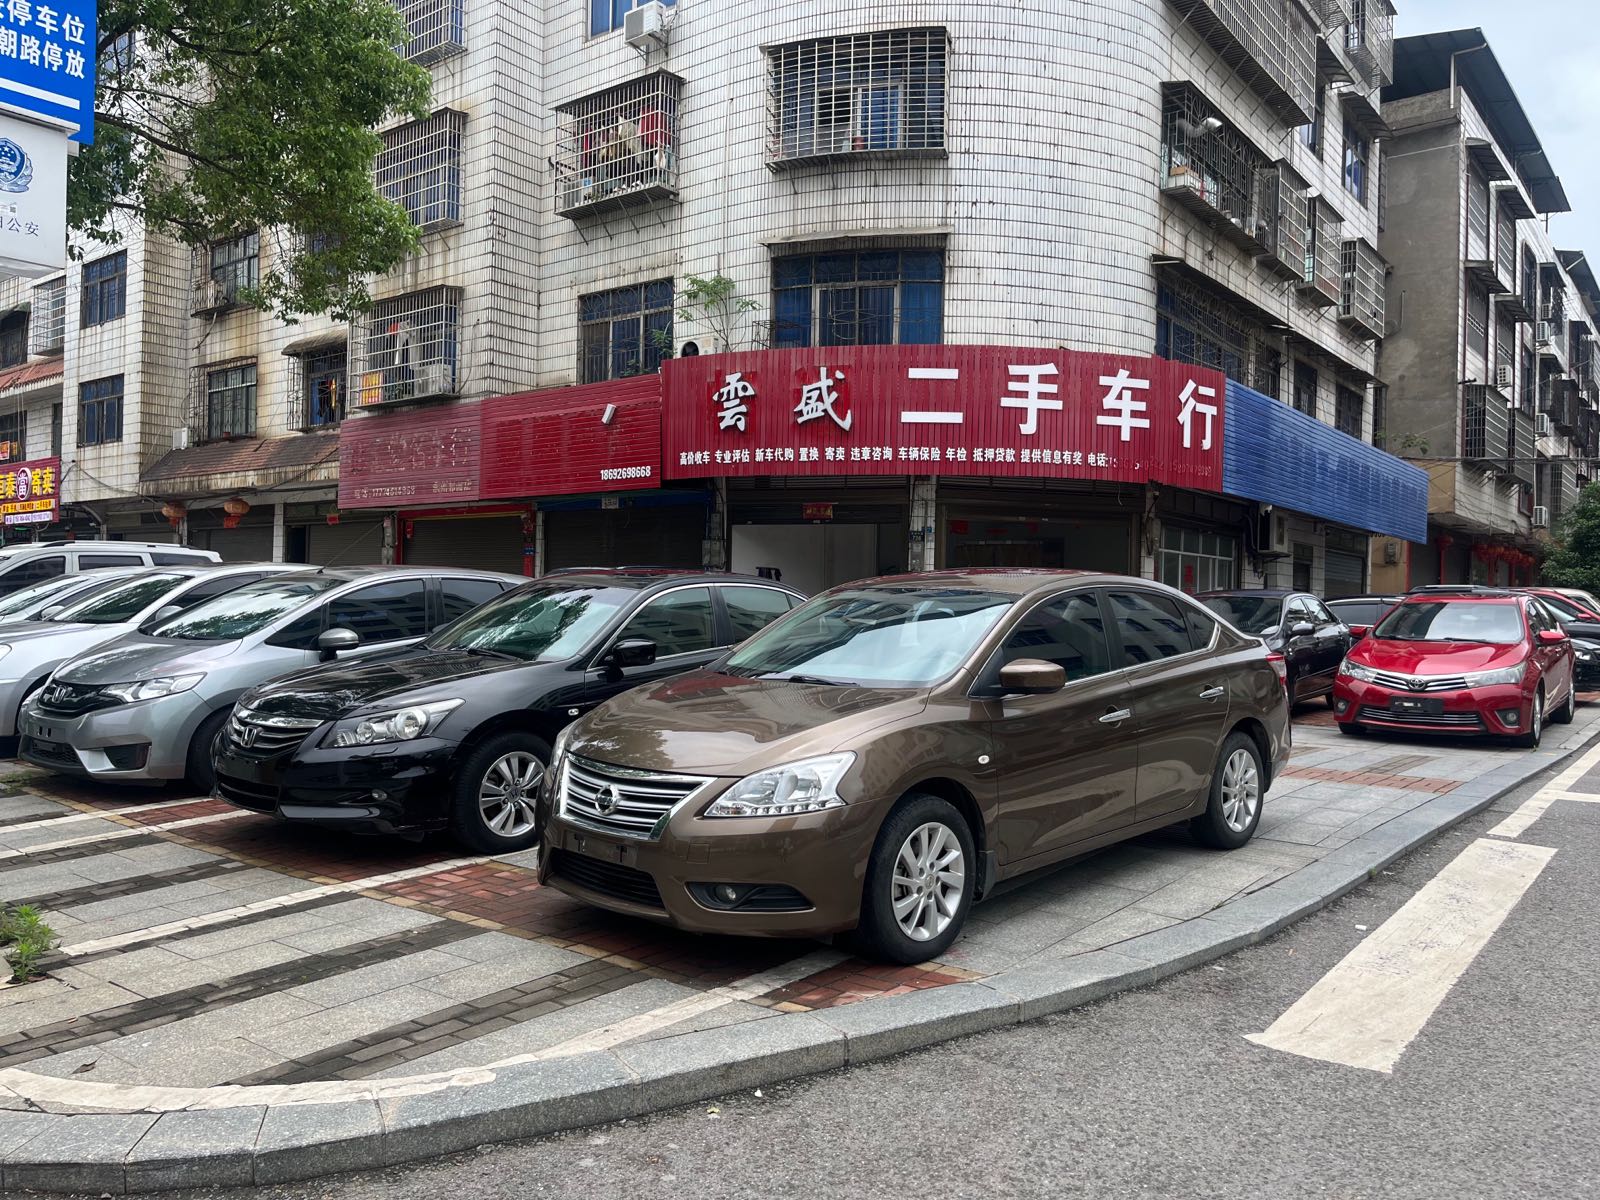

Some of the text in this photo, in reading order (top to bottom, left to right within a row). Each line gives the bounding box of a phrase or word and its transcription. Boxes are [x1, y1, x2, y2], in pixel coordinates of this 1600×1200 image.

[0, 0, 86, 45] 停车位
[0, 215, 39, 237] 公安
[680, 451, 711, 466] 高价收车
[714, 449, 751, 464] 专业评估
[755, 447, 795, 462] 新车代购
[798, 446, 820, 462] 置换
[824, 446, 846, 461] 寄卖
[850, 446, 893, 461] 违章咨询
[897, 446, 941, 461] 车辆保险
[945, 446, 967, 462] 年检
[973, 447, 1016, 463] 抵押贷款
[1020, 448, 1083, 466] 提供信息有奖
[600, 465, 652, 481] 18692698668
